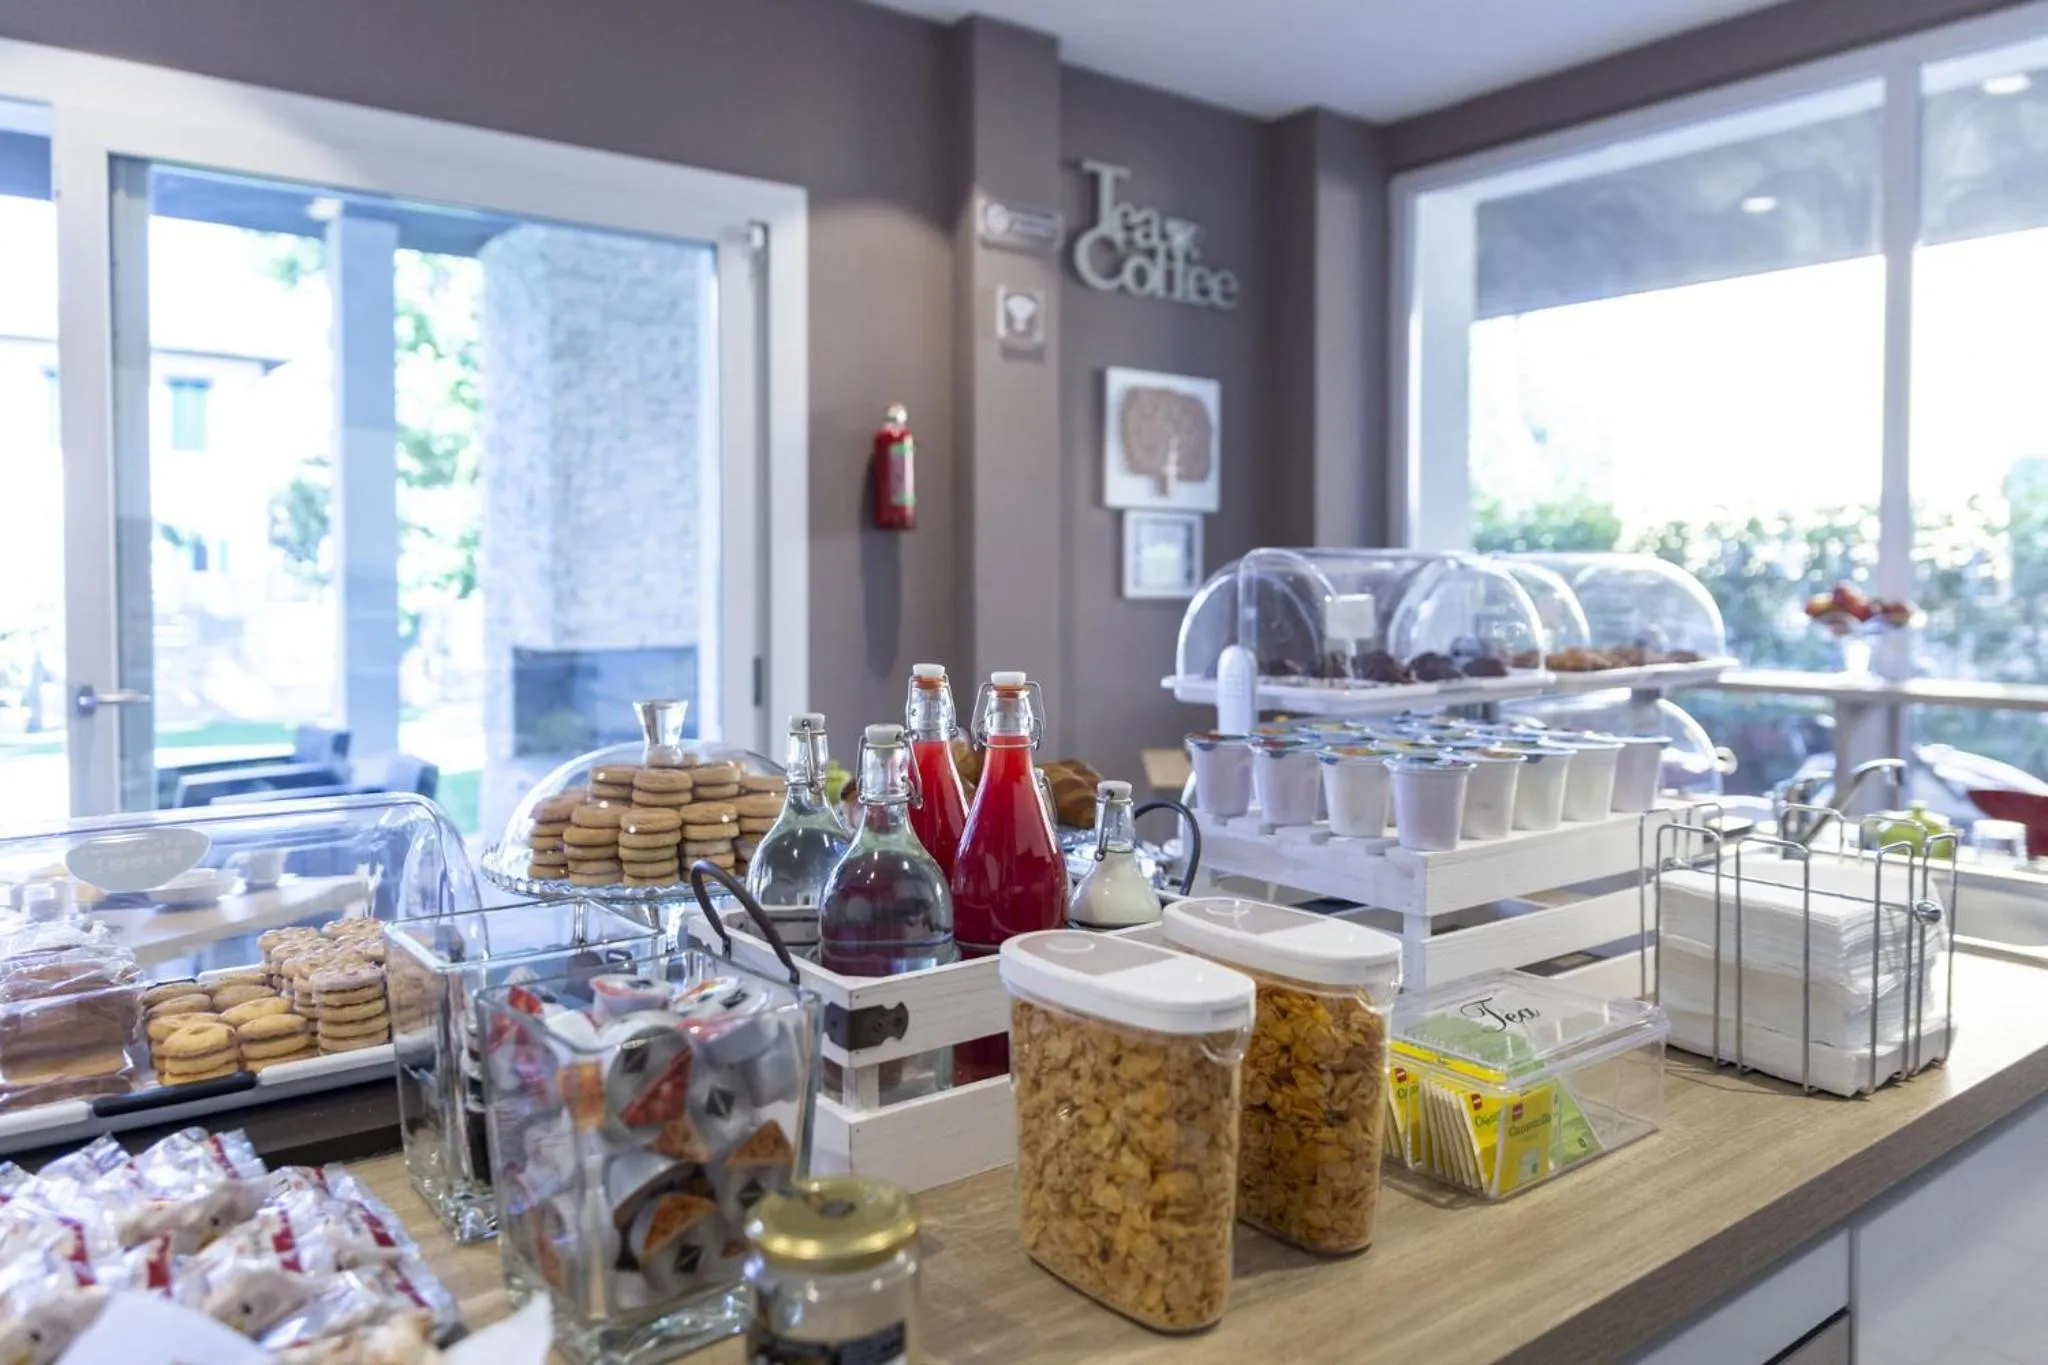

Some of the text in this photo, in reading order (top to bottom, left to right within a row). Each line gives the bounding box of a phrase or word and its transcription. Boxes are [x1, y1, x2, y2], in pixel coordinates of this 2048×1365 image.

[1082, 158, 1162, 248] Tea
[1074, 226, 1239, 309] Coffee
[1460, 997, 1540, 1033] Tea
